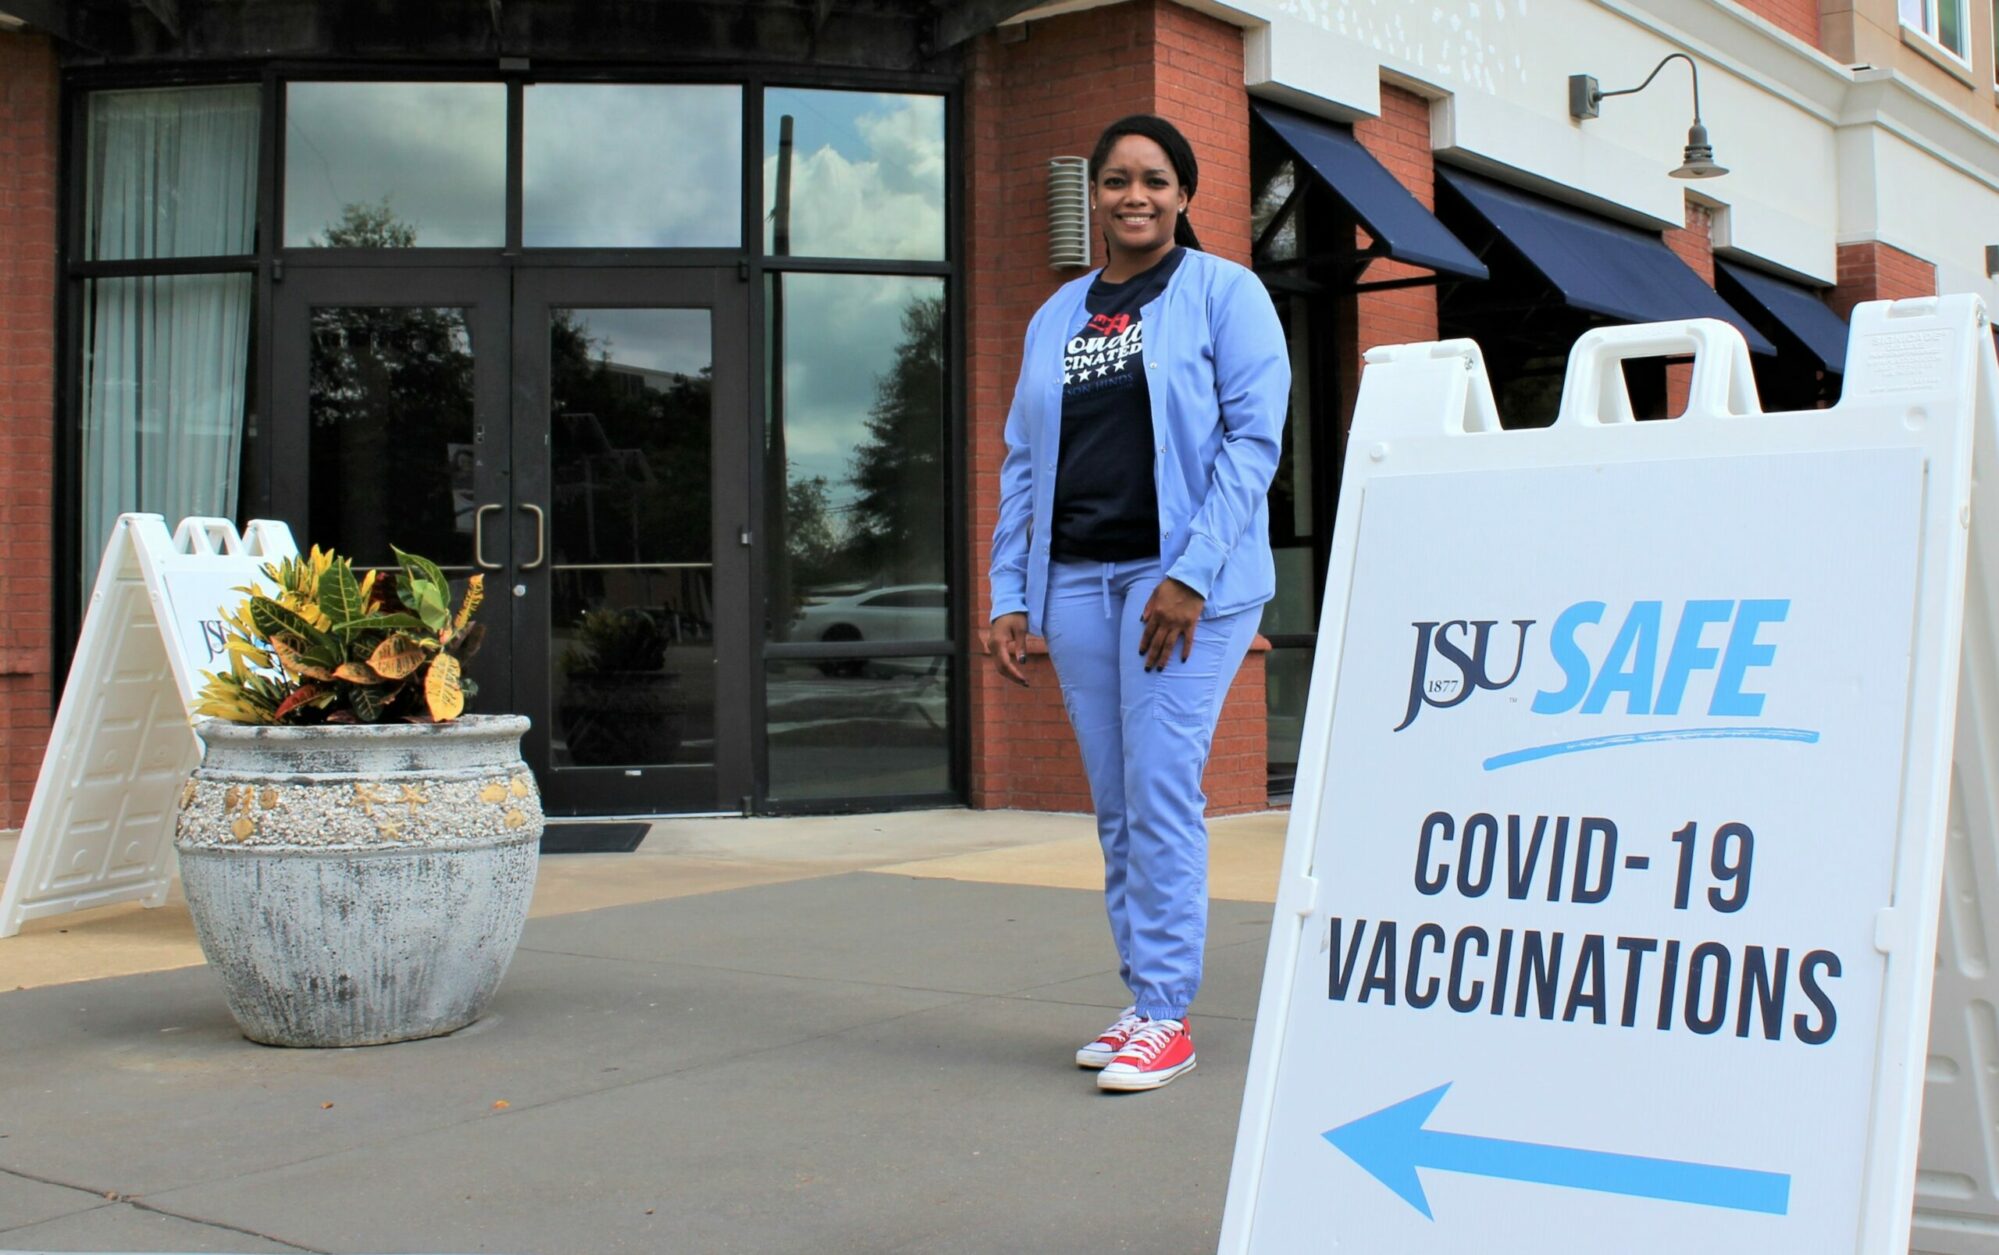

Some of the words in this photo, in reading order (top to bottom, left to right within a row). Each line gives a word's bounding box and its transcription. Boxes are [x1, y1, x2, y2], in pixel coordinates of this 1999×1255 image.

[1064, 343, 1143, 371] CINATED
[1393, 620, 1536, 732] JSU
[1530, 599, 1791, 716] SAFE
[1428, 680, 1458, 693] 1877
[1414, 811, 1754, 913] COVID-19
[1329, 917, 1842, 1046] VACCINATIONS
